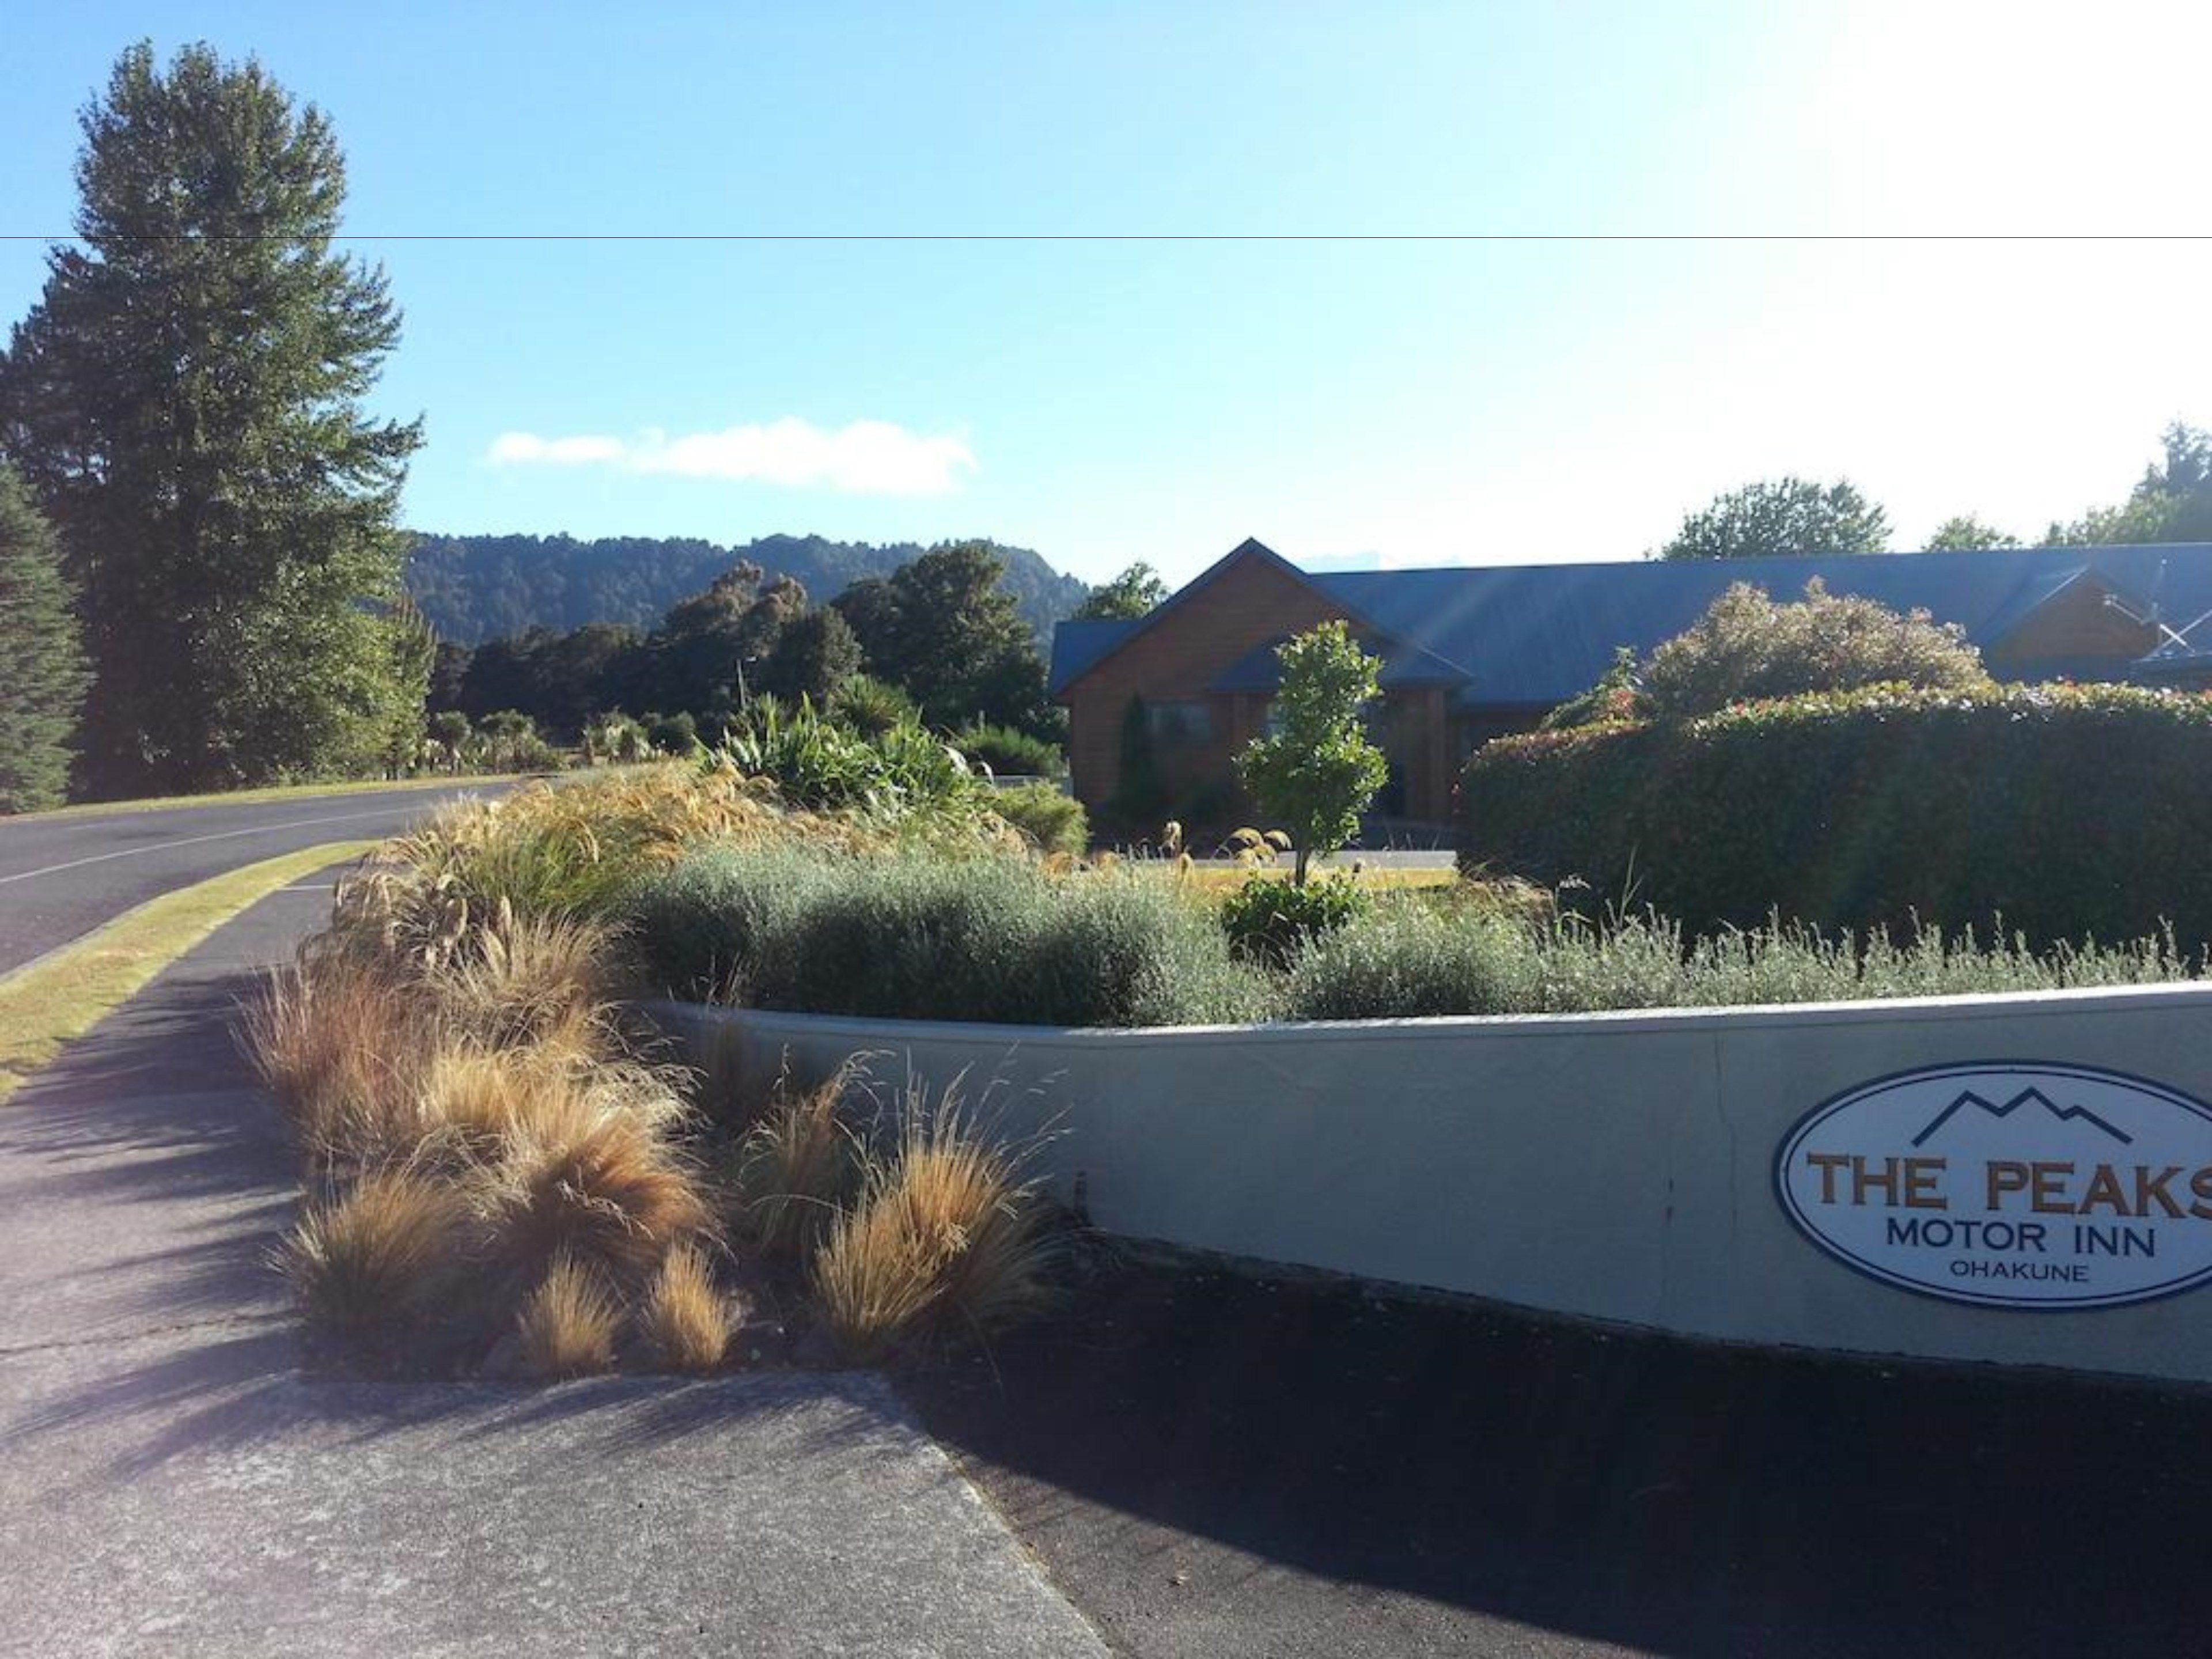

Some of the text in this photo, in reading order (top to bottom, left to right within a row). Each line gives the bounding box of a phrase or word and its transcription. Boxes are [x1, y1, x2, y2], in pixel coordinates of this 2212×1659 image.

[1807, 1153, 1948, 1210] THE
[1887, 1217, 2154, 1257] MOTOR INN
[1950, 1260, 2090, 1283] OHAKUNE
